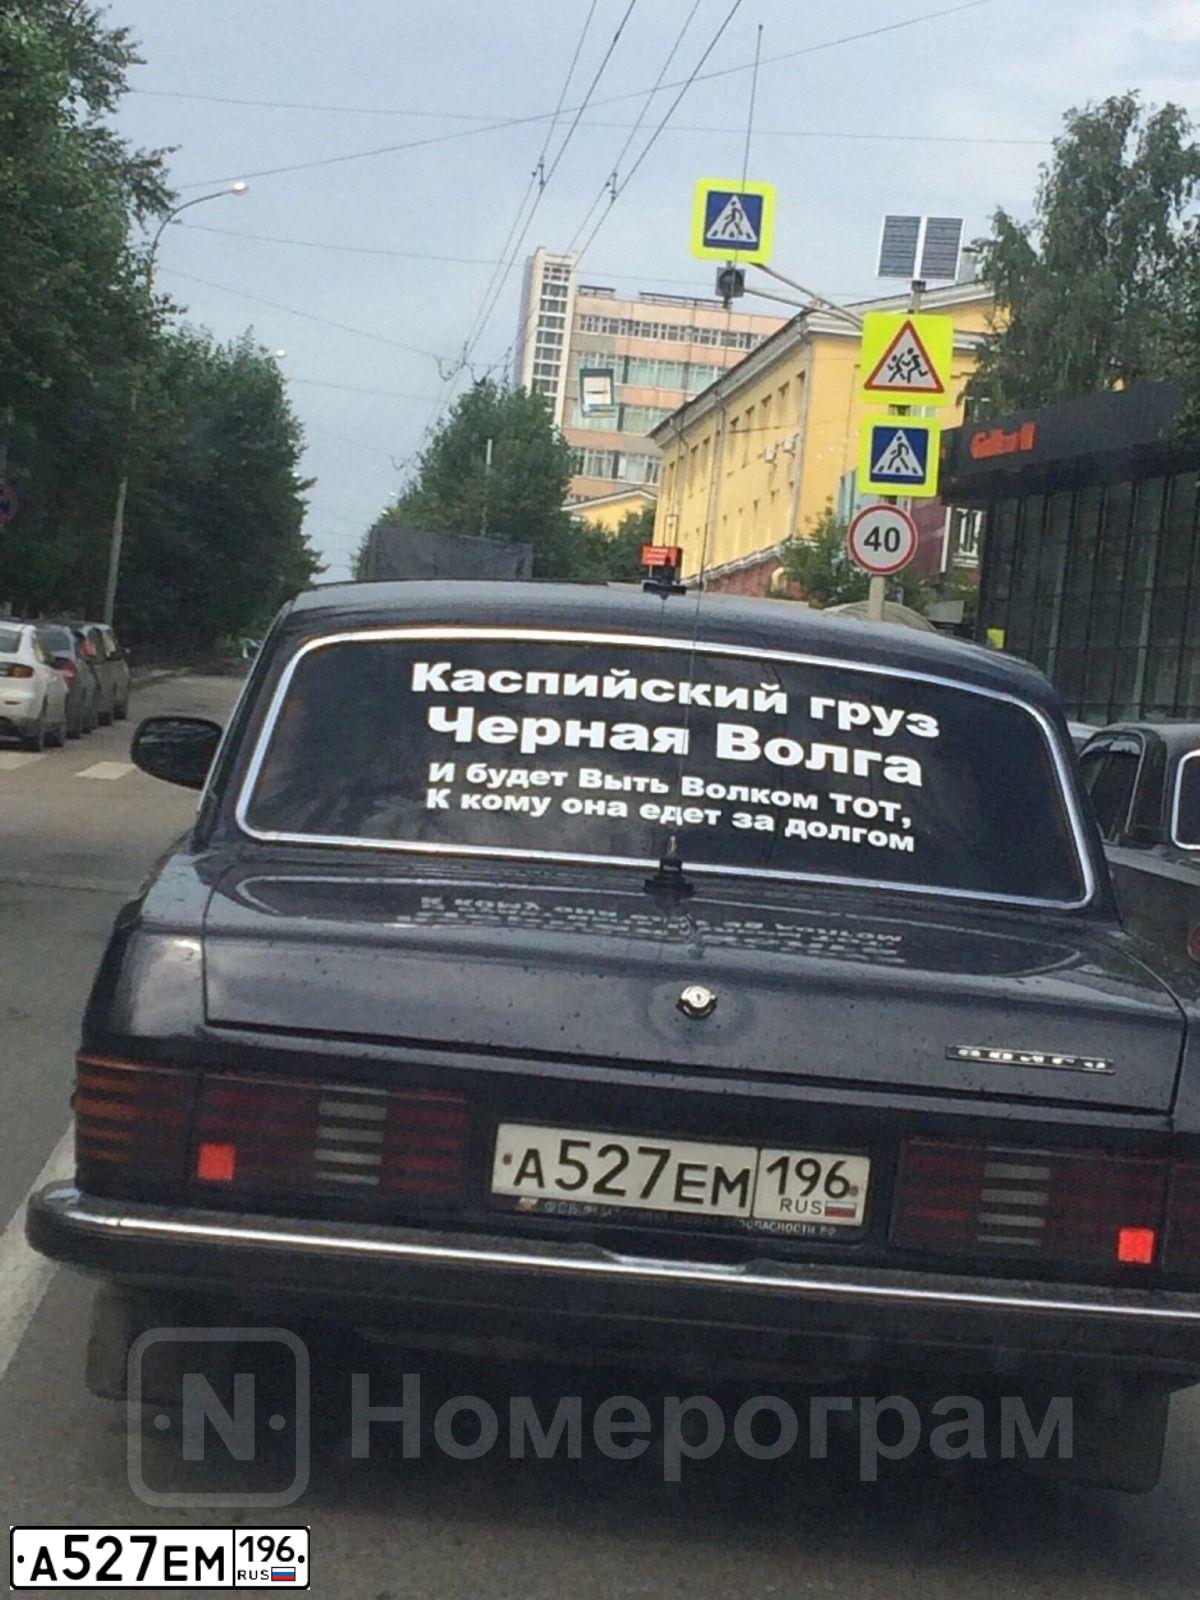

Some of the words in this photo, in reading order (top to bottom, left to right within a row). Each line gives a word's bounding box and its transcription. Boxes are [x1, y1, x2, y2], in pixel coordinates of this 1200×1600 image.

[864, 526, 901, 552] 40
[411, 661, 788, 715] Каспийский
[810, 696, 940, 738] груз
[428, 706, 690, 755] Черная
[716, 722, 923, 787] Волга
[428, 762, 456, 783] И
[466, 762, 569, 789] будет
[579, 767, 670, 794] Выть
[681, 775, 819, 811] Волком
[426, 787, 452, 810] К
[460, 793, 552, 818] кому
[561, 797, 629, 818] она
[639, 803, 722, 826] едет
[732, 812, 775, 832] за
[784, 818, 915, 853] долгом
[512, 1139, 751, 1209] А527ЕМ
[765, 1155, 850, 1199] 196
[779, 1197, 822, 1215] RUS
